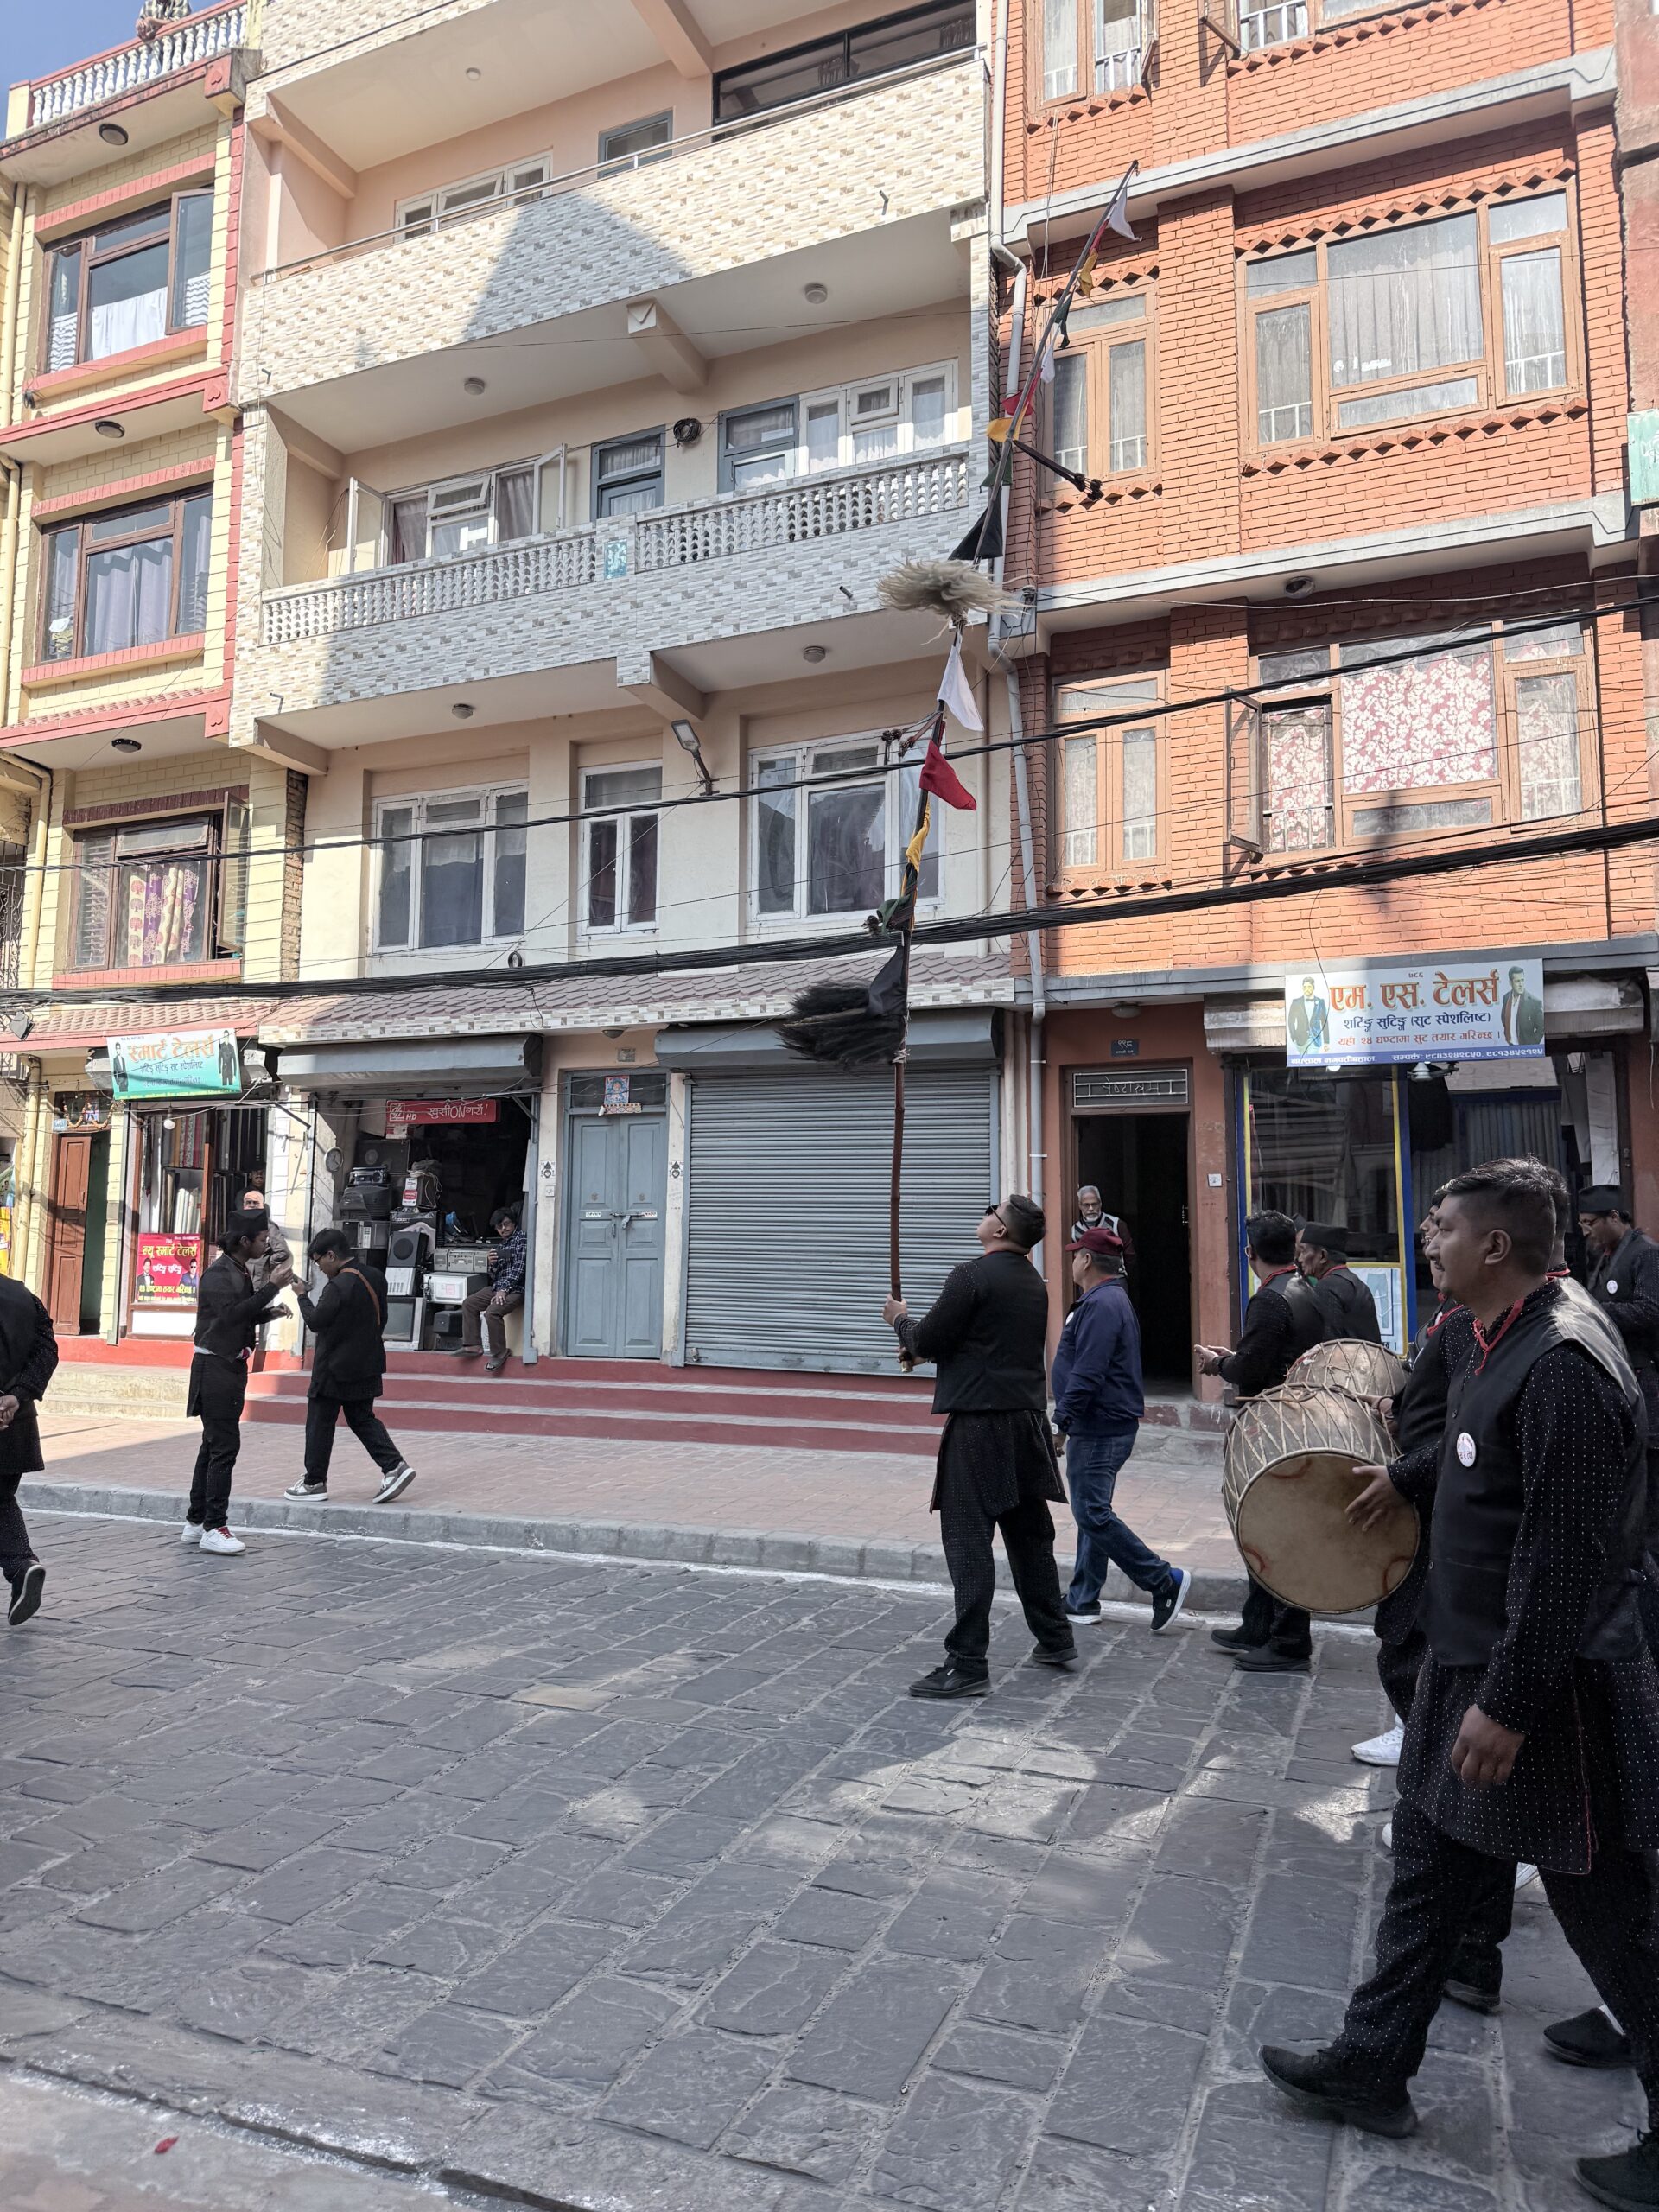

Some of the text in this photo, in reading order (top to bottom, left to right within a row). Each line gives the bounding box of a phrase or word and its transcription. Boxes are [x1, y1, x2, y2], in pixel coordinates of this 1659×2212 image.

[1330, 969, 1500, 1011] एम. एस. टेलर्स
[1411, 1014, 1432, 1028] (सुट
[1361, 1036, 1372, 1045] २४
[1376, 1034, 1409, 1044] घण्टामा
[1414, 1033, 1427, 1045] सुट
[1432, 1032, 1456, 1042] तयार
[1459, 1029, 1493, 1039] गरिन्छ
